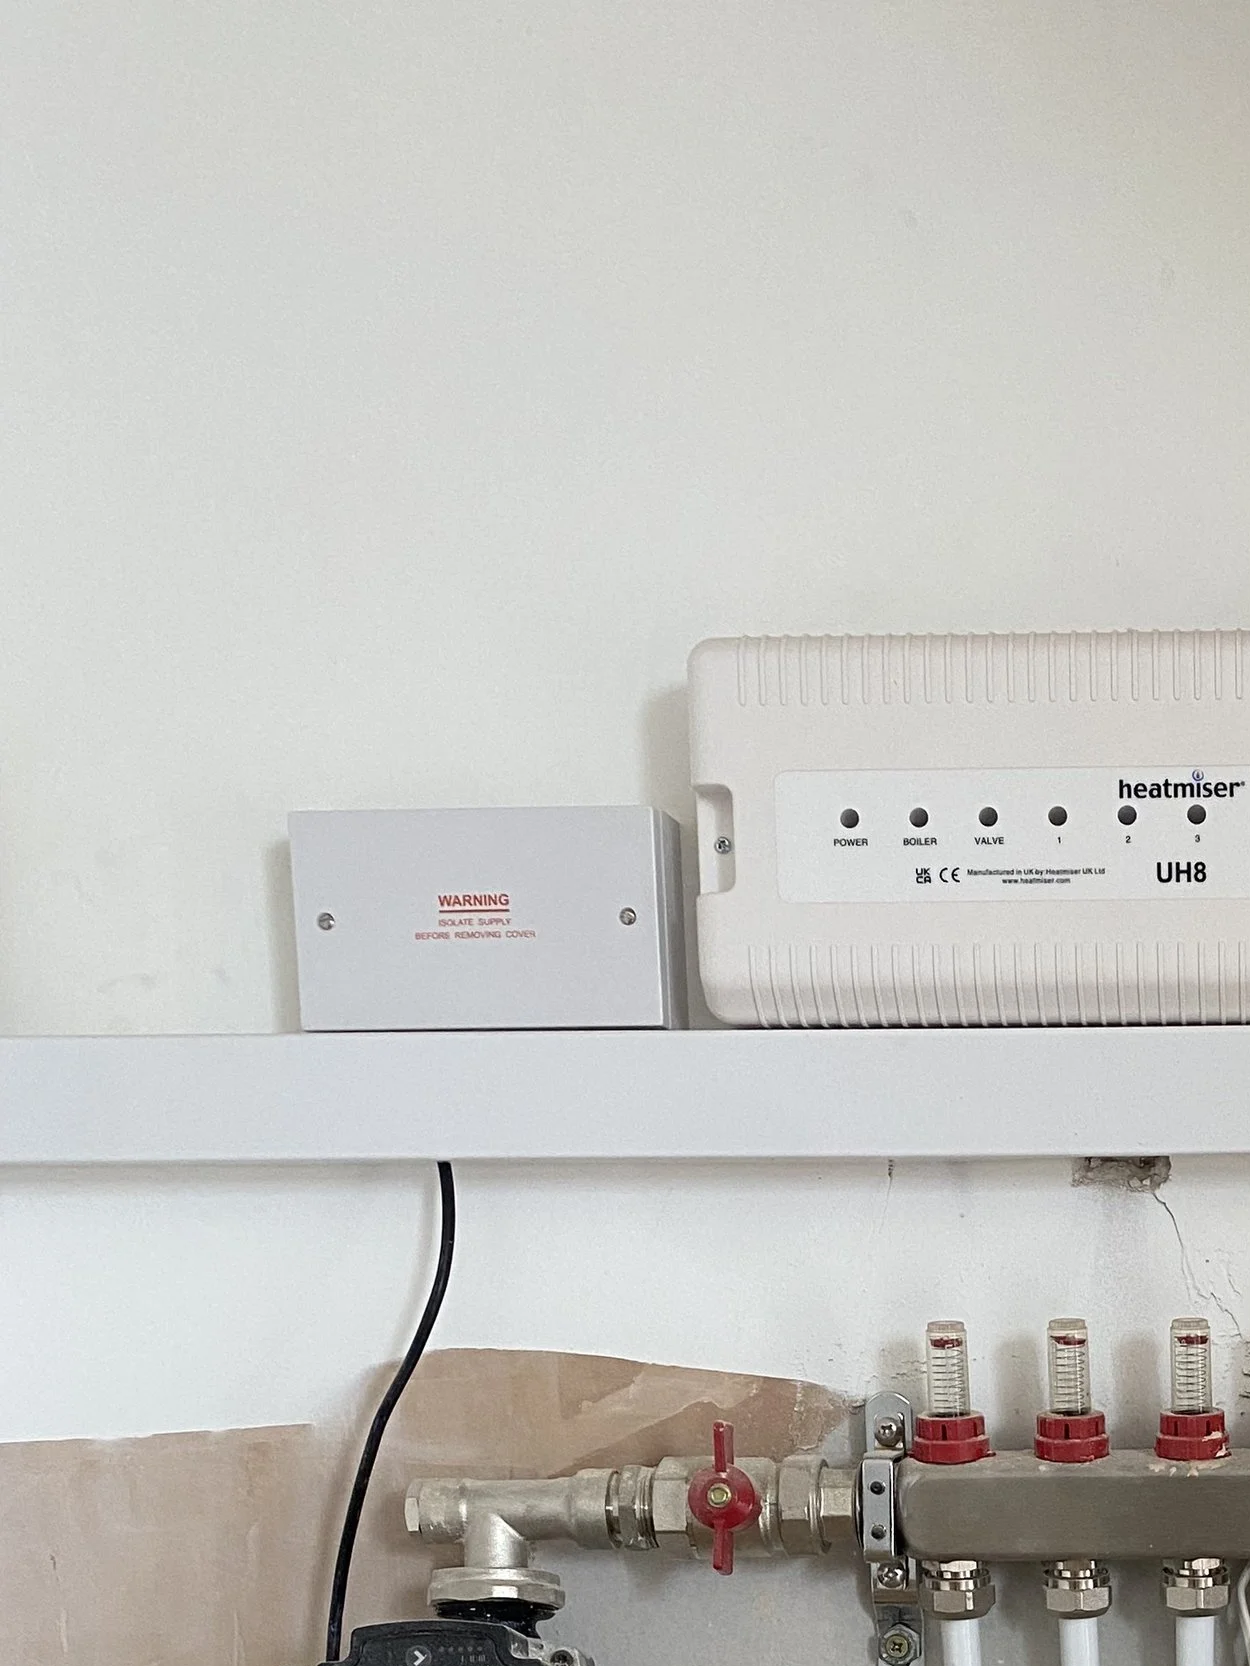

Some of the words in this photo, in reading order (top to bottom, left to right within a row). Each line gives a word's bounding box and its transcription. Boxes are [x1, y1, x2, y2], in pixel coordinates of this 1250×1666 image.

[833, 838, 869, 847] POWER
[902, 837, 938, 846] BOILER
[974, 836, 1005, 845] VALVE
[1057, 836, 1062, 845] 1
[1125, 835, 1132, 844] 2
[1194, 834, 1201, 843] 3
[915, 867, 931, 876] UK
[967, 868, 1015, 876] Manufactured
[1023, 868, 1034, 876] UK
[1082, 867, 1094, 875] UK
[1094, 867, 1106, 875] Ltd
[1156, 862, 1207, 883] UH8
[916, 876, 931, 884] CA
[438, 893, 510, 907] WARNING
[438, 918, 473, 927] ISOLATE
[477, 917, 512, 926] SUPPLY
[454, 930, 502, 940] REMOVING
[505, 930, 537, 939] COVER
